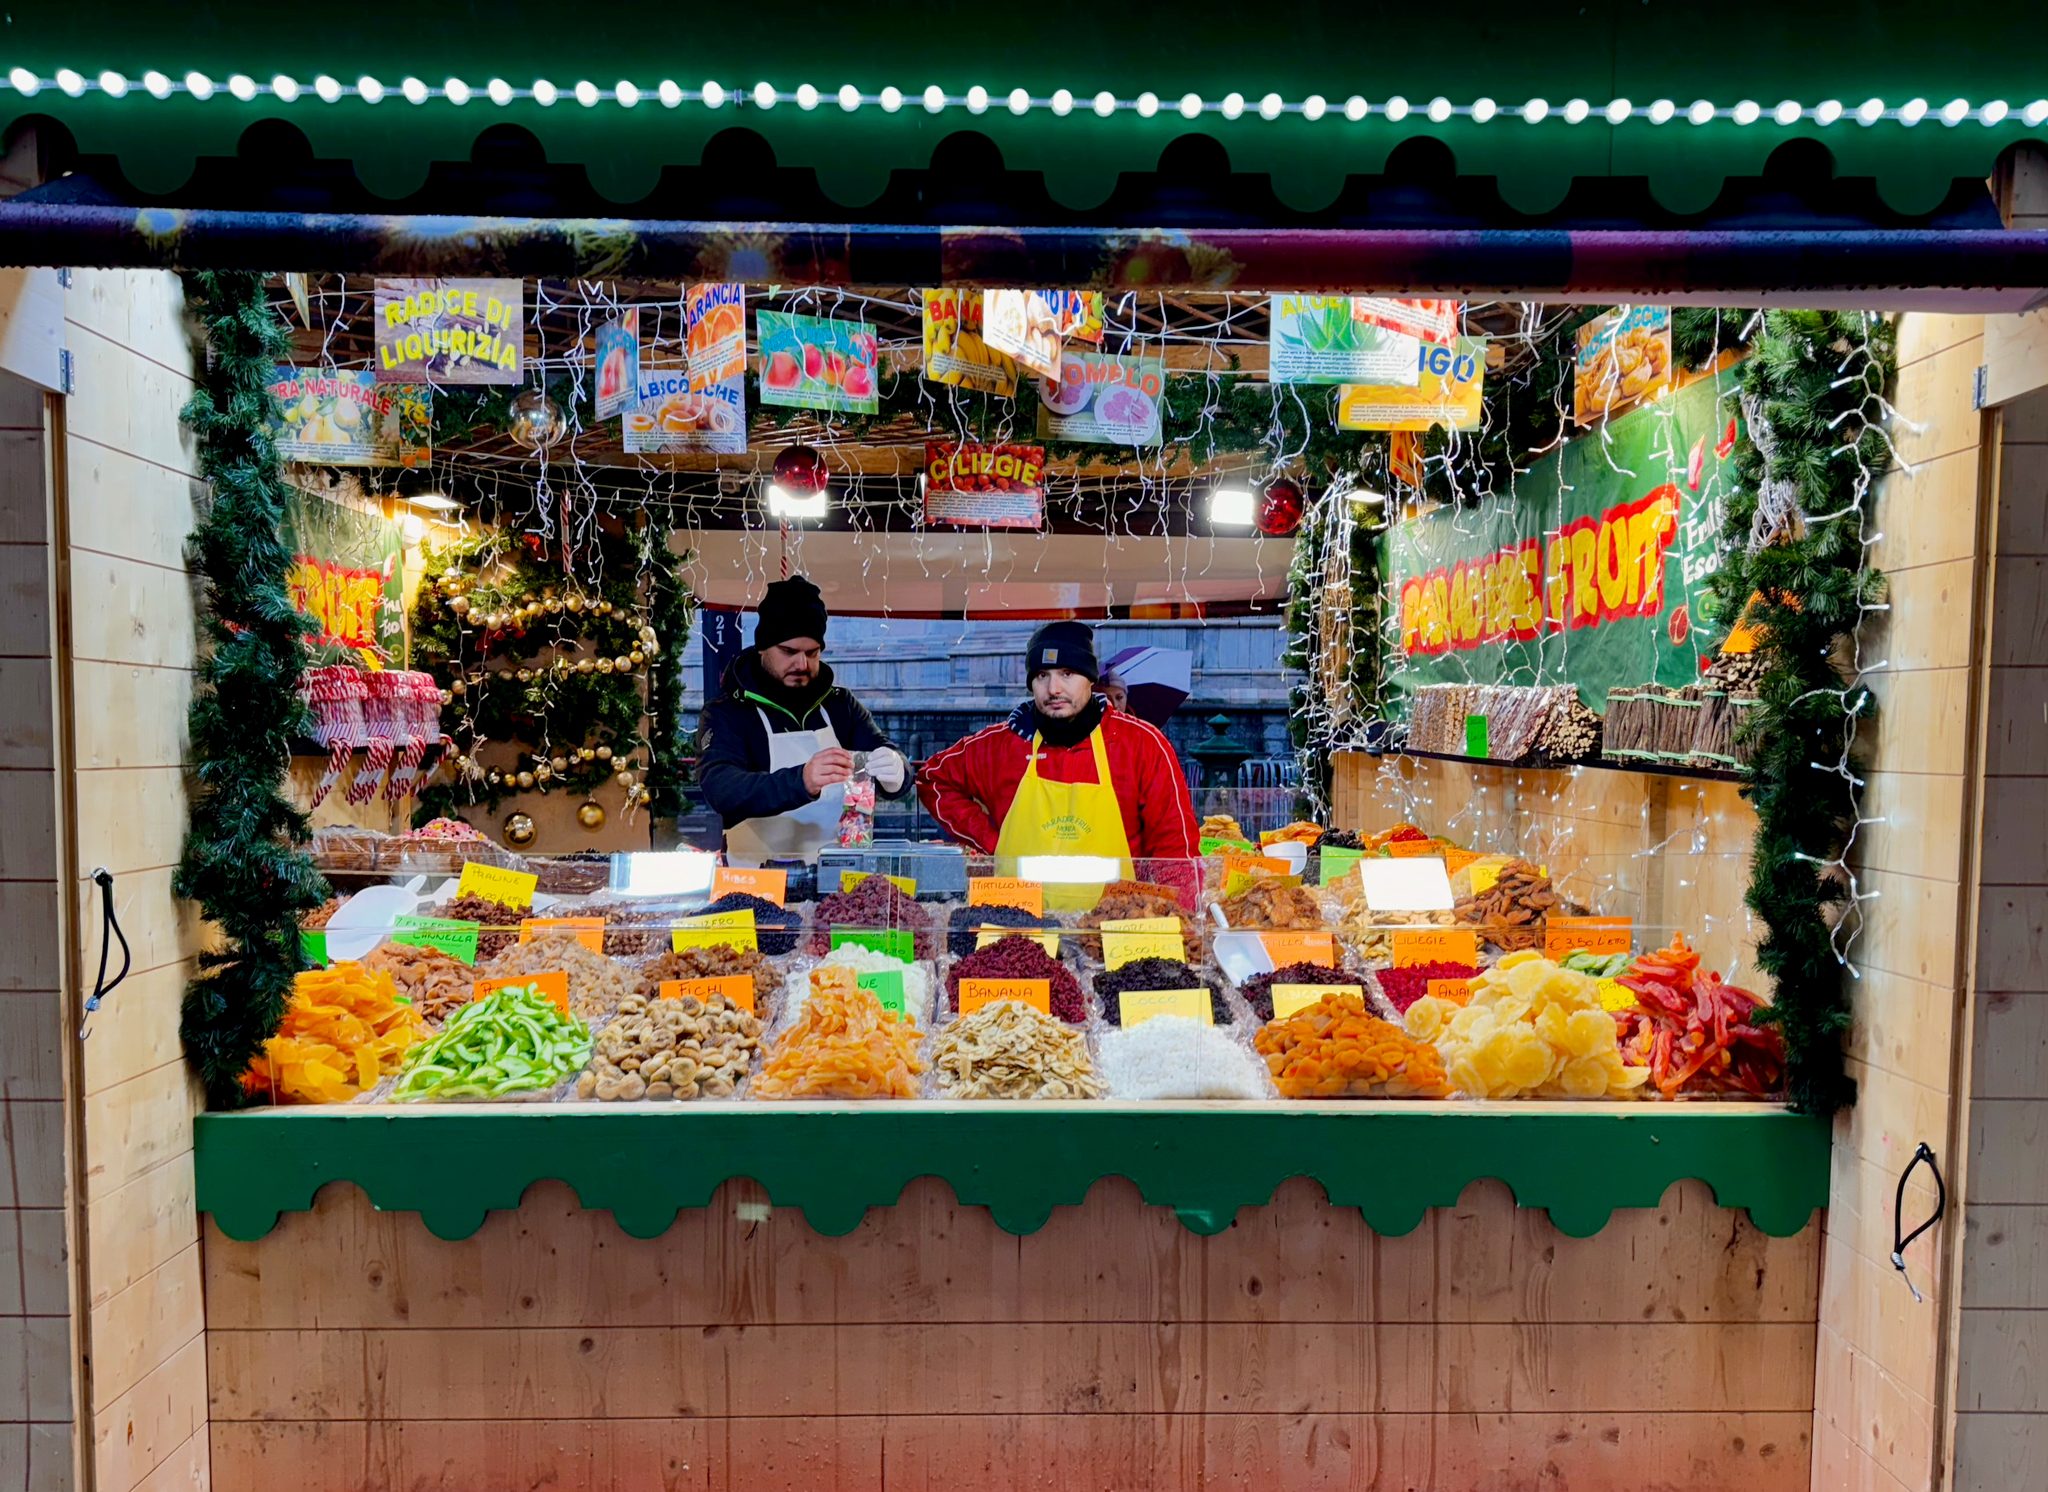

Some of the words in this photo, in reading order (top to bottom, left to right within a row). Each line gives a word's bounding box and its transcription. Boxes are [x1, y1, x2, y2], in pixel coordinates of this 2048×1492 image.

[384, 288, 478, 329] RADICE
[487, 296, 512, 331] DI
[688, 284, 741, 331] ARANCIA
[380, 330, 517, 372] LIQUIRIZIA
[304, 378, 392, 416] NATURALE
[1047, 362, 1161, 397] OMELO
[930, 452, 1039, 488] CILIEGIE
[1547, 490, 1670, 625] FRUIT
[472, 866, 520, 885] PRALINE
[1394, 935, 1447, 945] CILIEGIE
[678, 981, 722, 997] FICHI
[967, 980, 1033, 998] BANANA
